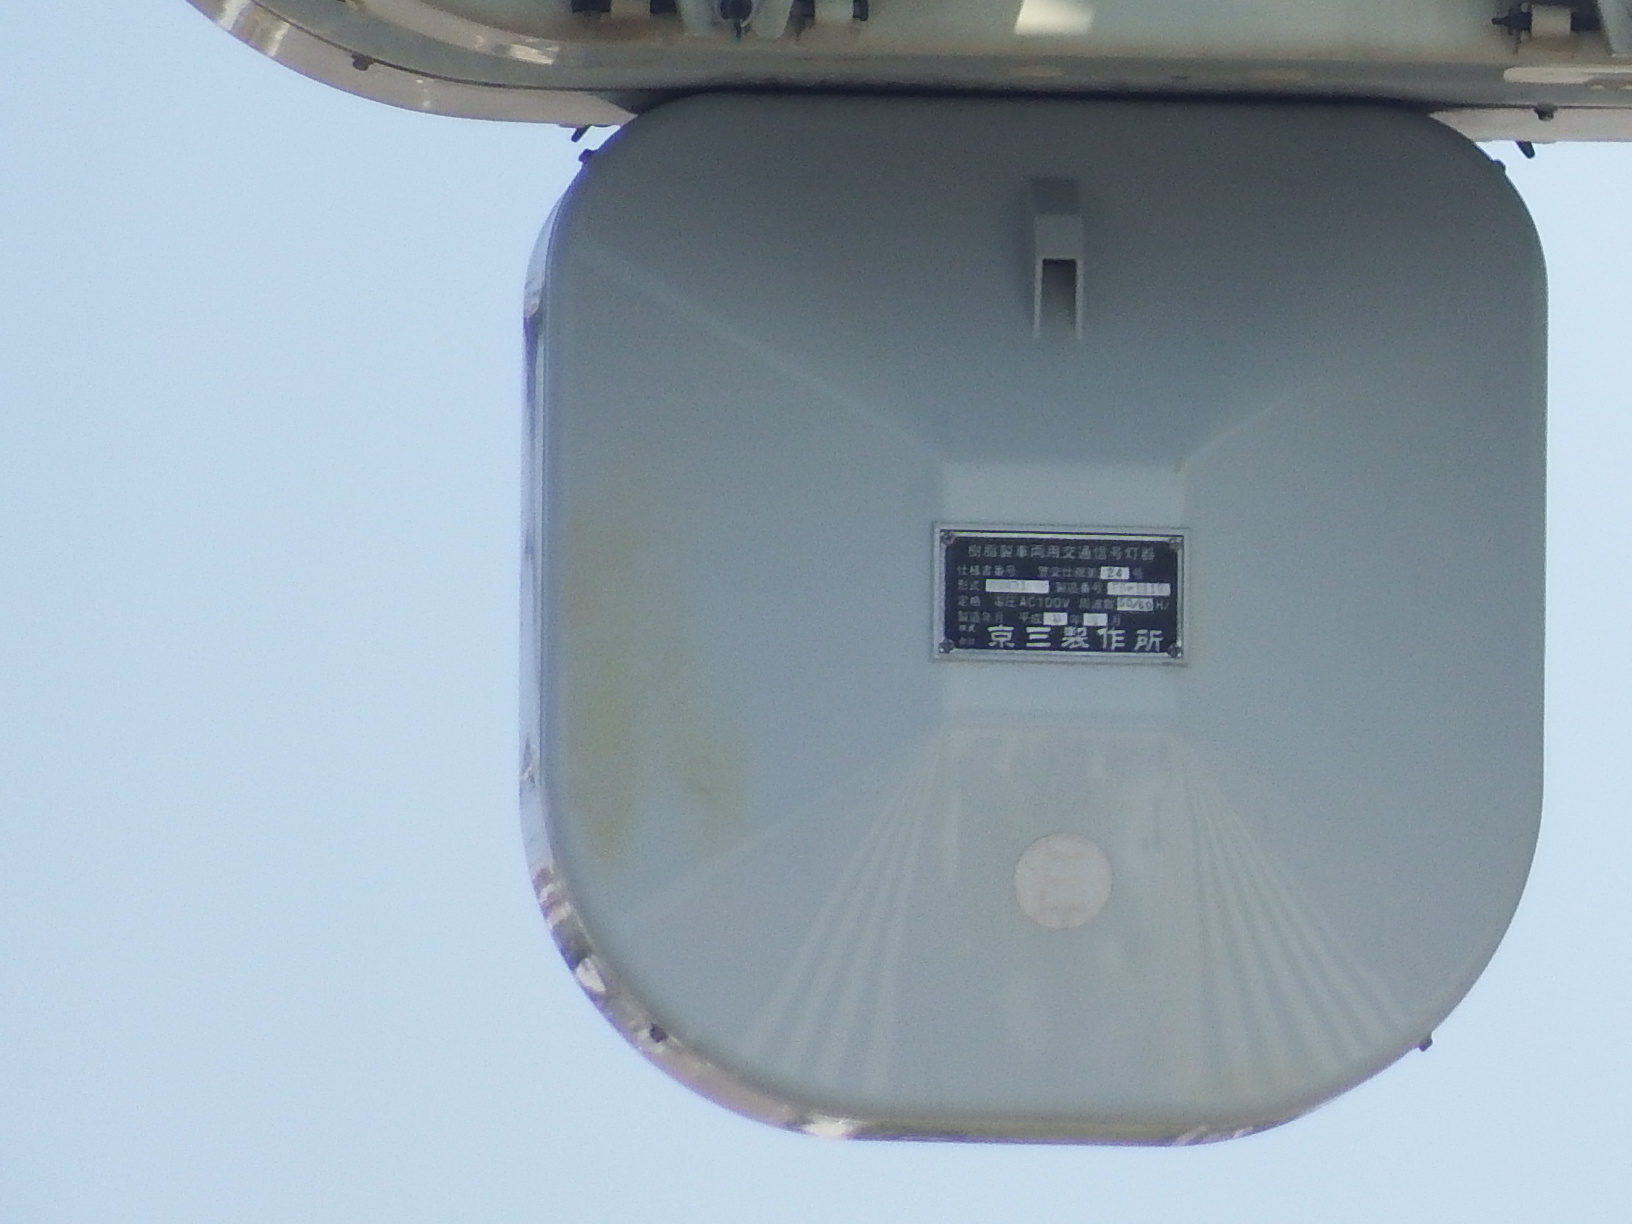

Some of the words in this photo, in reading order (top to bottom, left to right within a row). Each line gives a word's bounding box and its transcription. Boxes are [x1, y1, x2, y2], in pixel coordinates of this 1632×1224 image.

[987, 625, 1164, 652] 京三製作所
